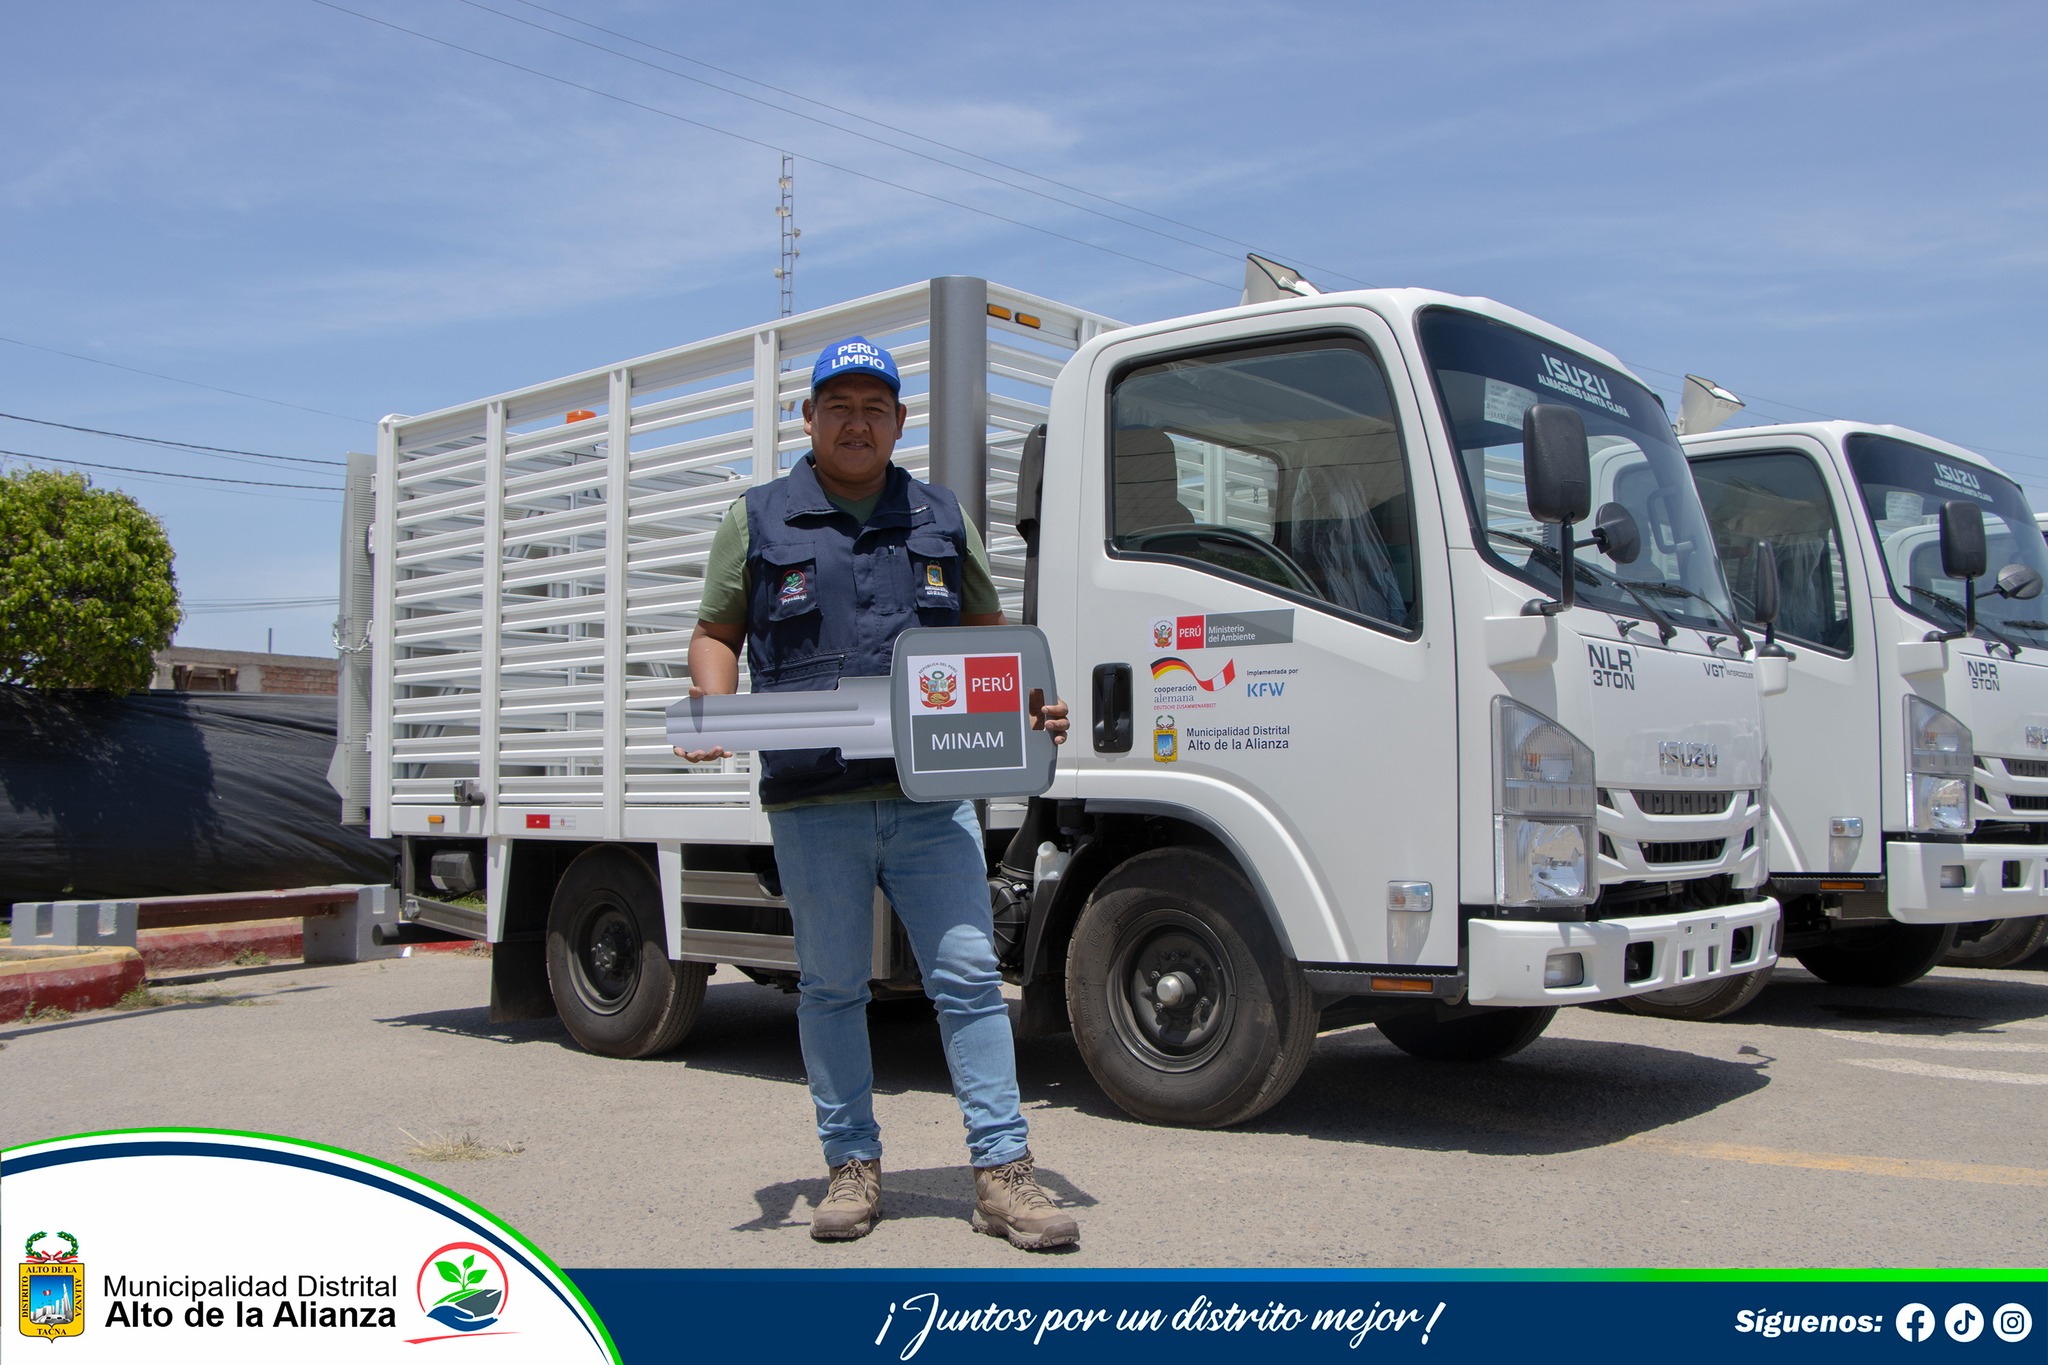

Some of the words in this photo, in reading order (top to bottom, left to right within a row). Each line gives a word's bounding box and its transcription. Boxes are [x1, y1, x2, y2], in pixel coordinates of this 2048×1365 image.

[837, 342, 879, 356] PERÚ
[831, 354, 885, 370] LIMPIO
[1541, 353, 1612, 400] ISUZU
[1537, 373, 1583, 399] ALMACENES
[1582, 390, 1607, 408] SANTA
[1606, 400, 1630, 418] CLARA
[1934, 461, 1980, 490] ISUZU
[1179, 625, 1202, 638] PERÚ
[1208, 624, 1245, 634] Ministerio
[1208, 634, 1220, 643] del
[1220, 633, 1256, 642] Ambiente
[1588, 644, 1633, 673] NLR
[1702, 662, 1724, 679] VGT
[1967, 660, 1999, 680] NPR
[971, 672, 1014, 693] PERÚ
[1592, 669, 1635, 691] 3TON
[1971, 677, 2000, 692] 5TON
[1153, 683, 1197, 694] cooperación
[1153, 693, 1195, 703] alemana
[1187, 726, 1250, 739] Municipalidad
[1252, 724, 1291, 736] Distrital
[931, 731, 1004, 751] MINAM
[1187, 738, 1211, 751] Alto
[1214, 738, 1229, 750] de
[1231, 737, 1242, 750] la
[1244, 737, 1290, 750] Alianza
[1658, 740, 1718, 770] ISUZU
